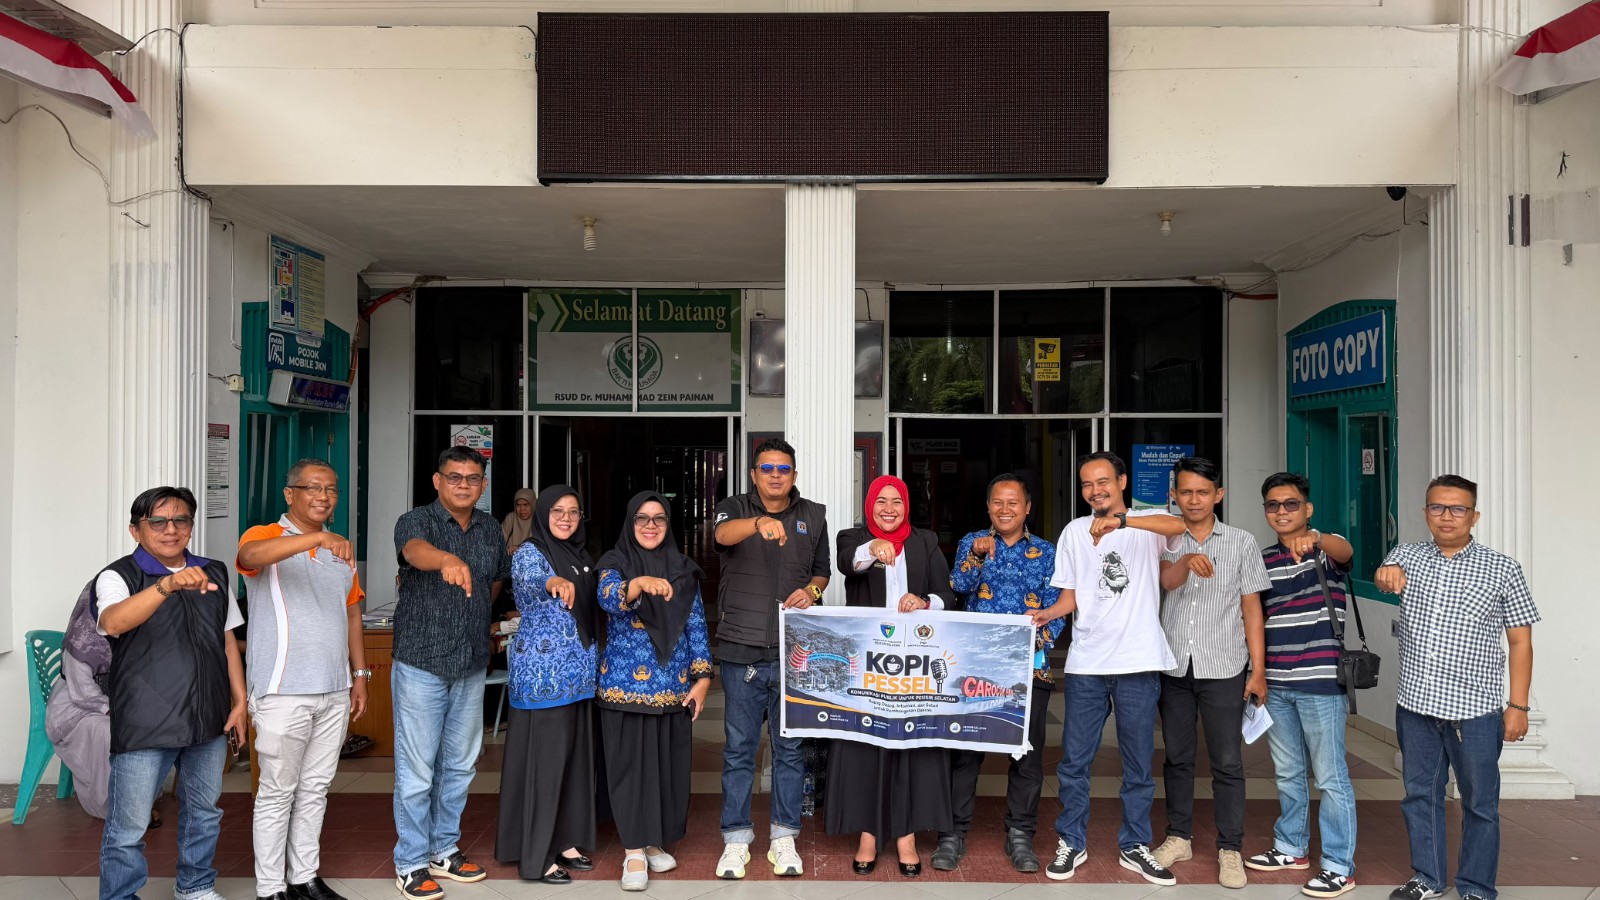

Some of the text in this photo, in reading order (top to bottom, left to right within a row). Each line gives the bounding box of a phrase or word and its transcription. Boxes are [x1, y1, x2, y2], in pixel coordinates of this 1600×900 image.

[572, 298, 726, 330] Selamat Datang
[297, 347, 319, 360] POJOK
[1292, 327, 1380, 383] FOTO COPY
[288, 356, 326, 371] MOBILE JKN
[595, 394, 655, 402] MUHAMMAD
[658, 394, 678, 402] ZEIN
[680, 394, 714, 402] PAINAN
[866, 651, 930, 676] KOPI
[864, 672, 936, 694] PESSEL
[850, 689, 880, 698] KOMUNIKASI
